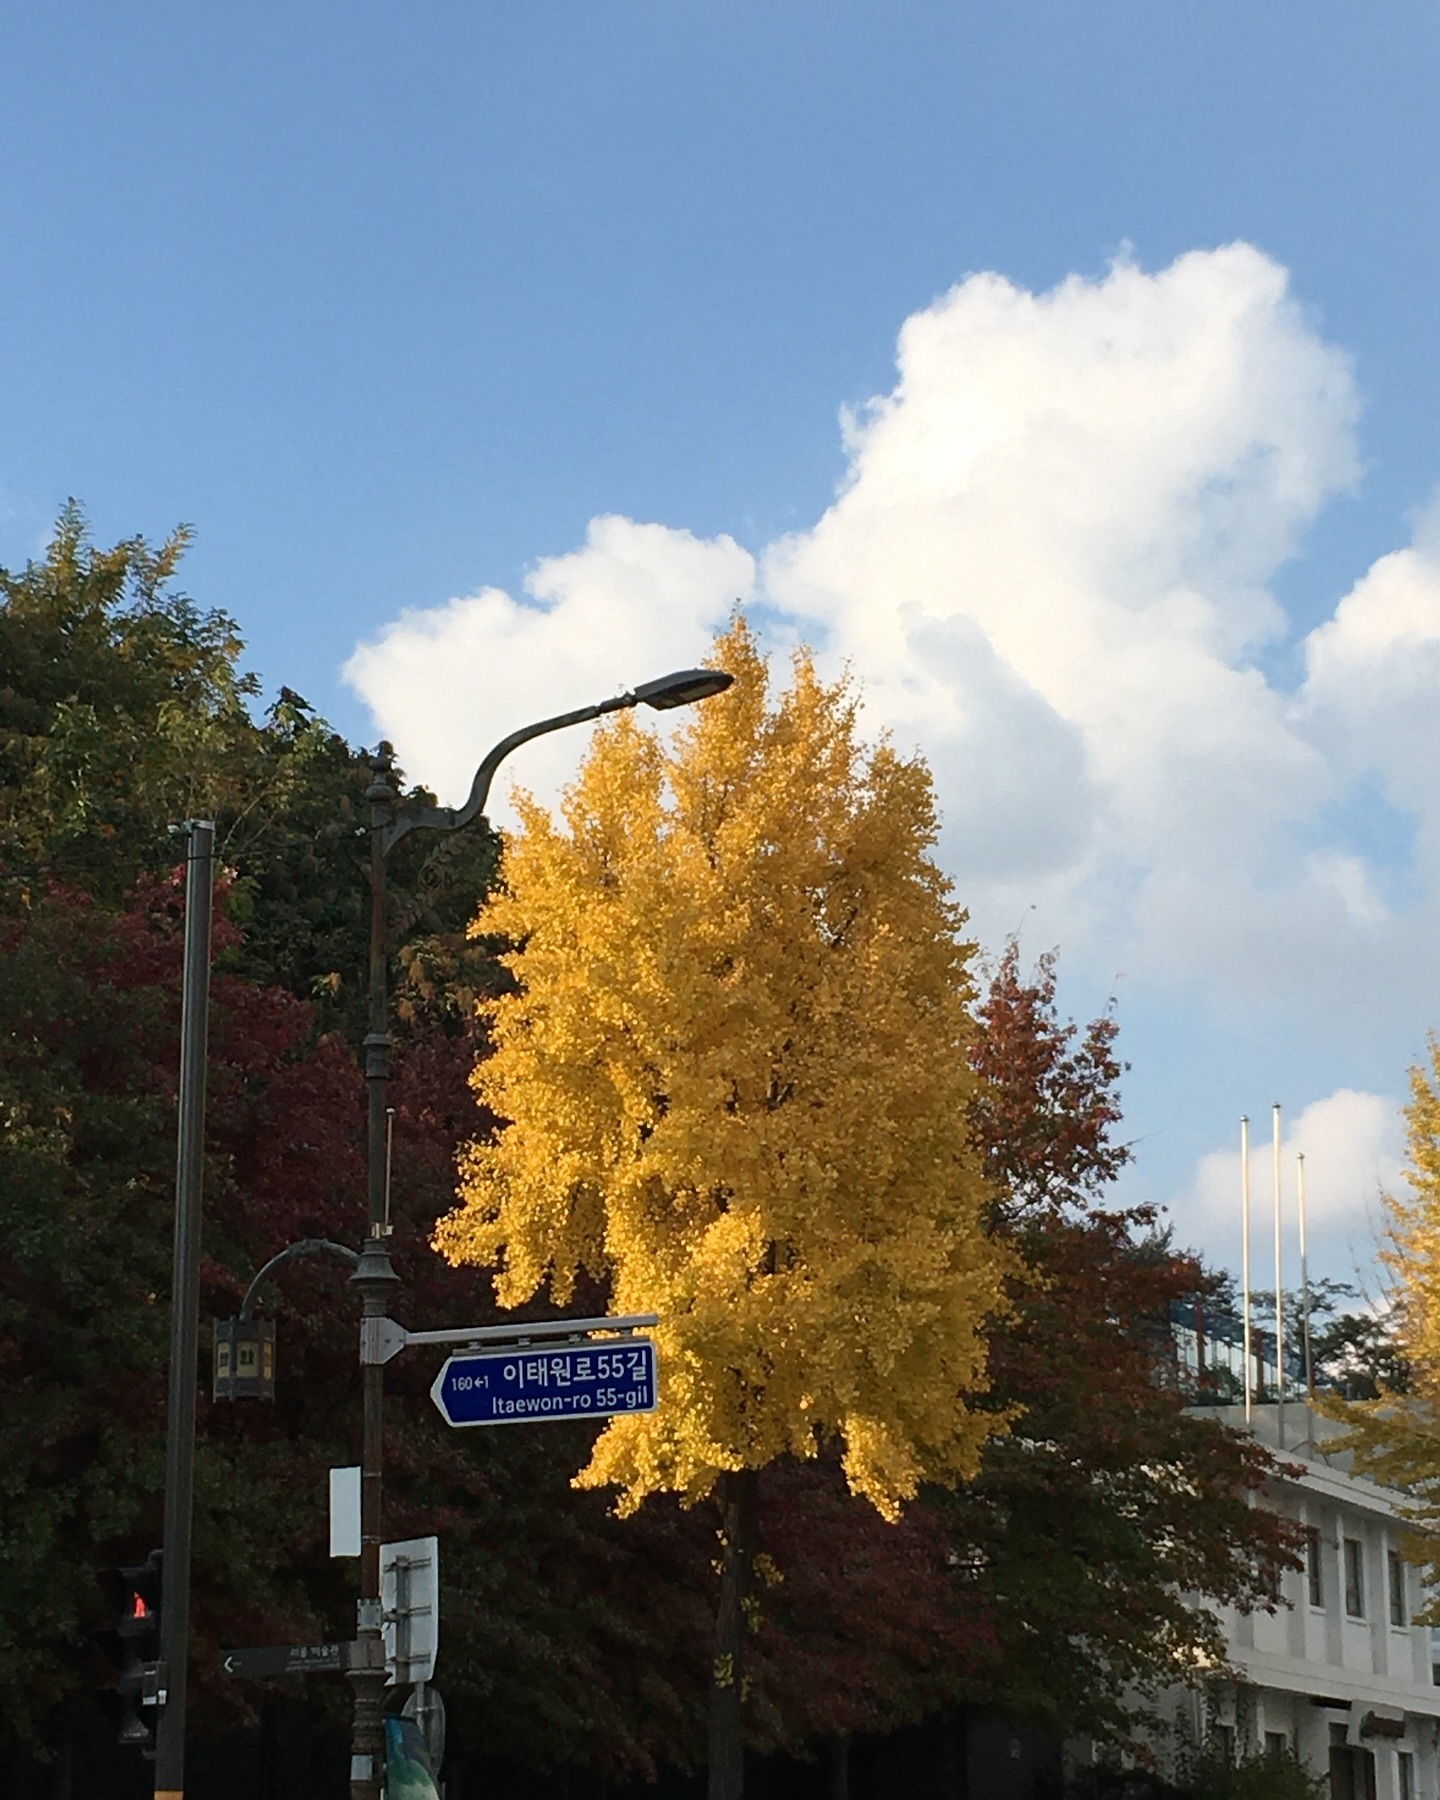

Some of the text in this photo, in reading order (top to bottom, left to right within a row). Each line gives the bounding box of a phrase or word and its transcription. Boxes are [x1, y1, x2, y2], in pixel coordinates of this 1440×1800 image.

[503, 1350, 647, 1388] 이태원로55길
[492, 1386, 648, 1414] Itaewon-ro 55-gil
